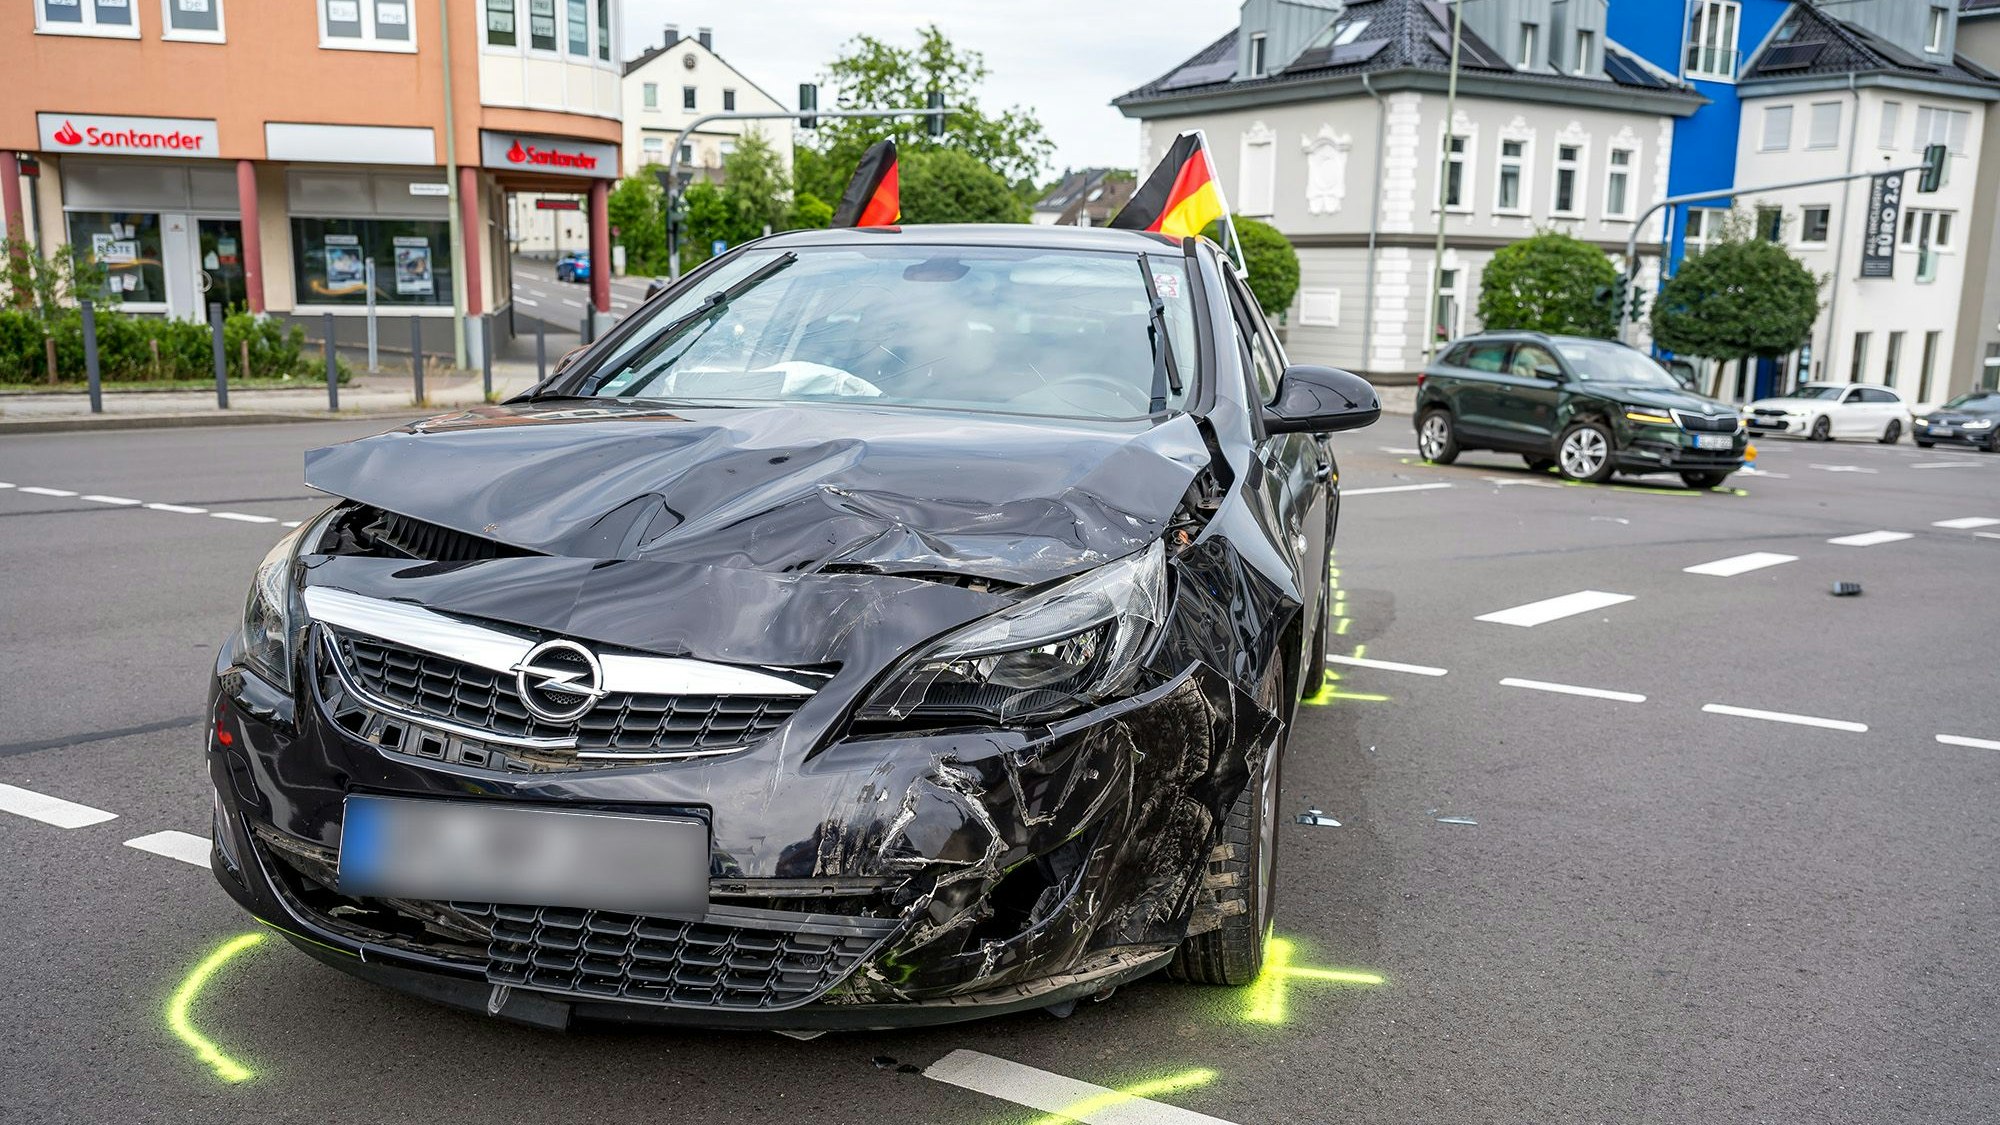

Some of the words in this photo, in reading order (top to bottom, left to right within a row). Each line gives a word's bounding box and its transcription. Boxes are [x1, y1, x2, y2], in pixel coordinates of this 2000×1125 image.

[86, 127, 203, 151] Santander
[526, 145, 598, 170] Santander
[1884, 177, 1901, 205] 2.0
[1877, 207, 1896, 257] BÜRO
